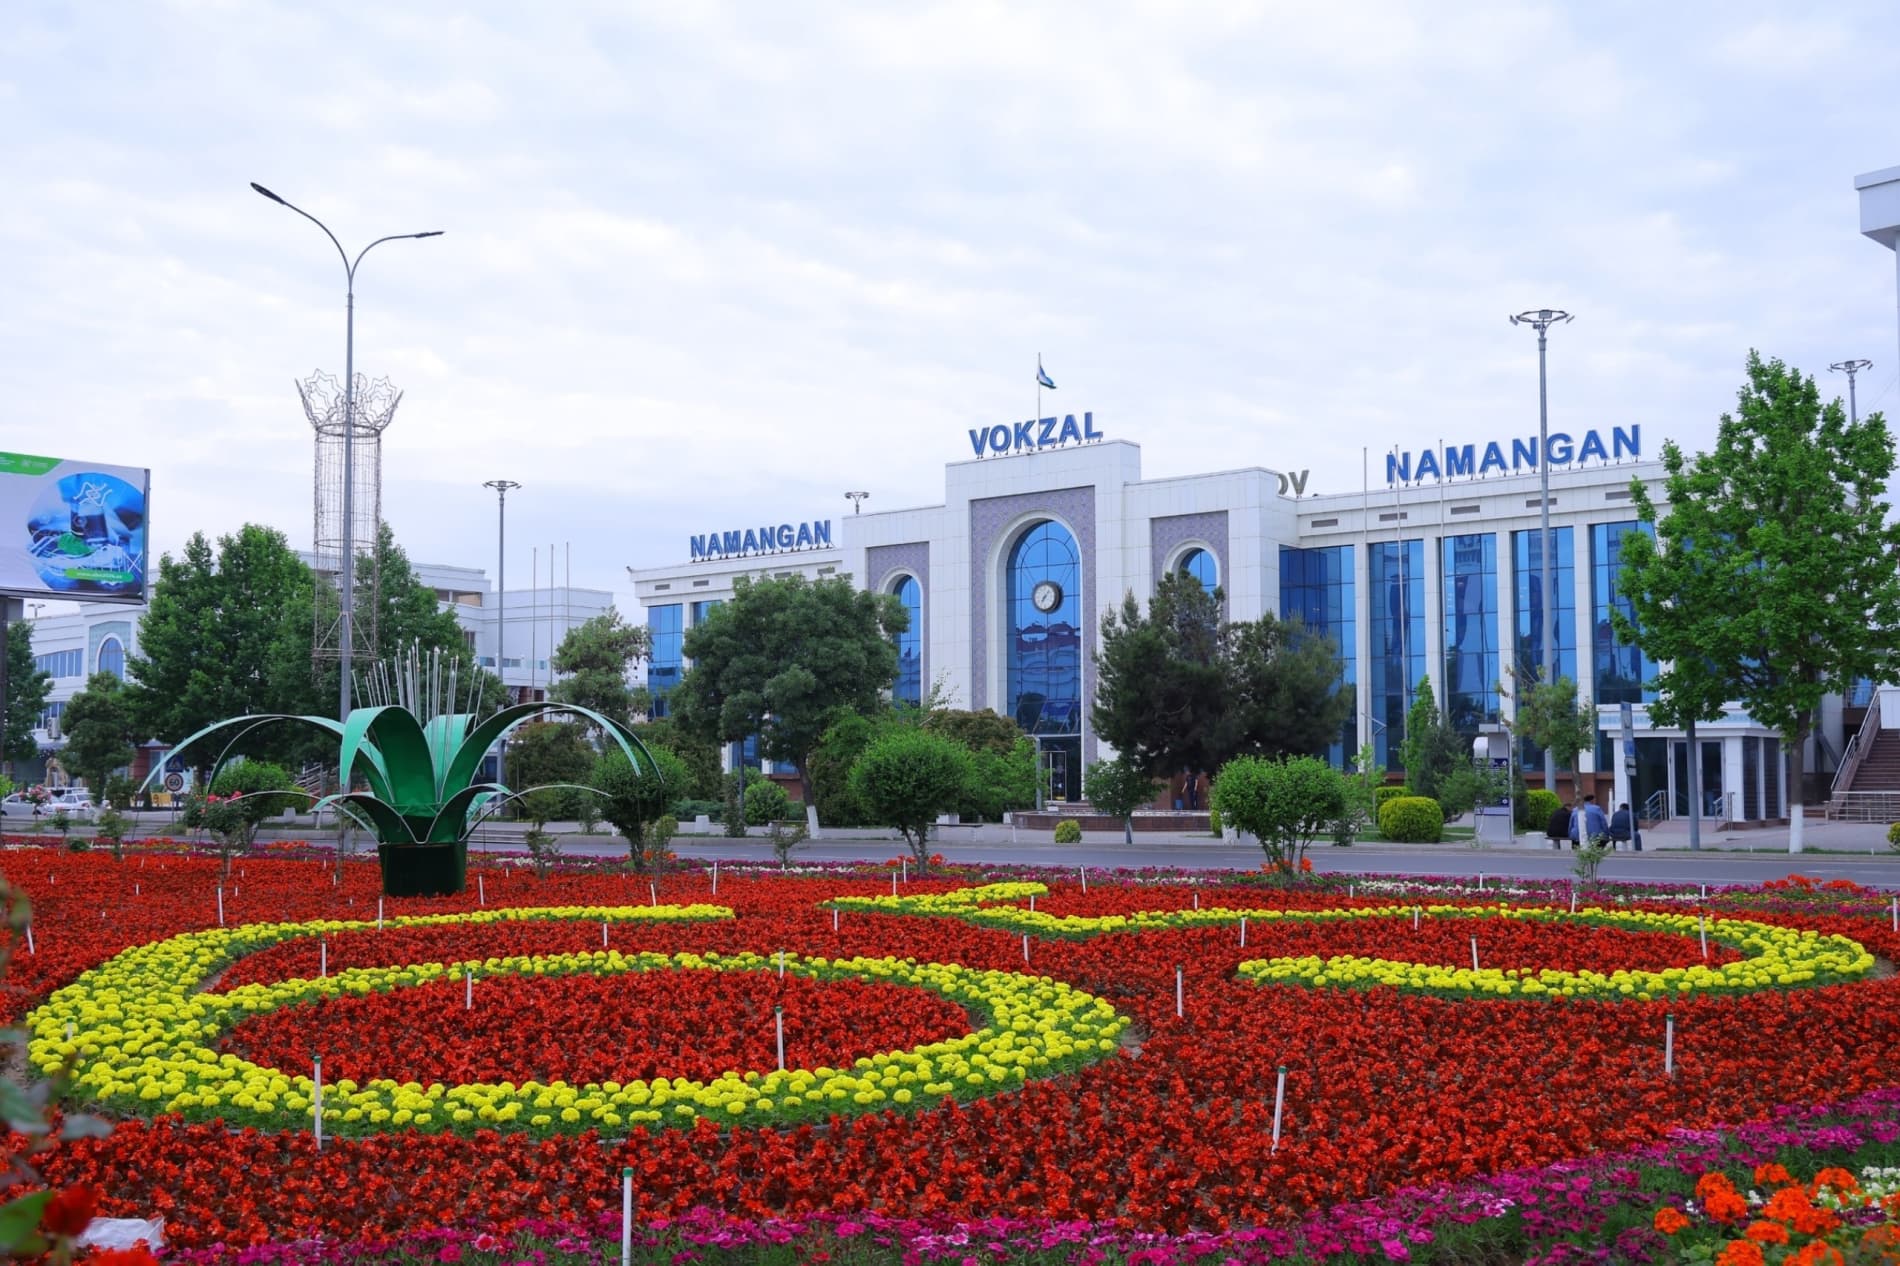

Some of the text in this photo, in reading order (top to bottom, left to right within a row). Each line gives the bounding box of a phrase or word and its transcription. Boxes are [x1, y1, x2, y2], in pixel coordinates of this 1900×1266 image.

[968, 411, 1104, 456] VOKZAL
[1386, 424, 1641, 484] NAMANGAN
[690, 520, 831, 558] NAMANGAN
